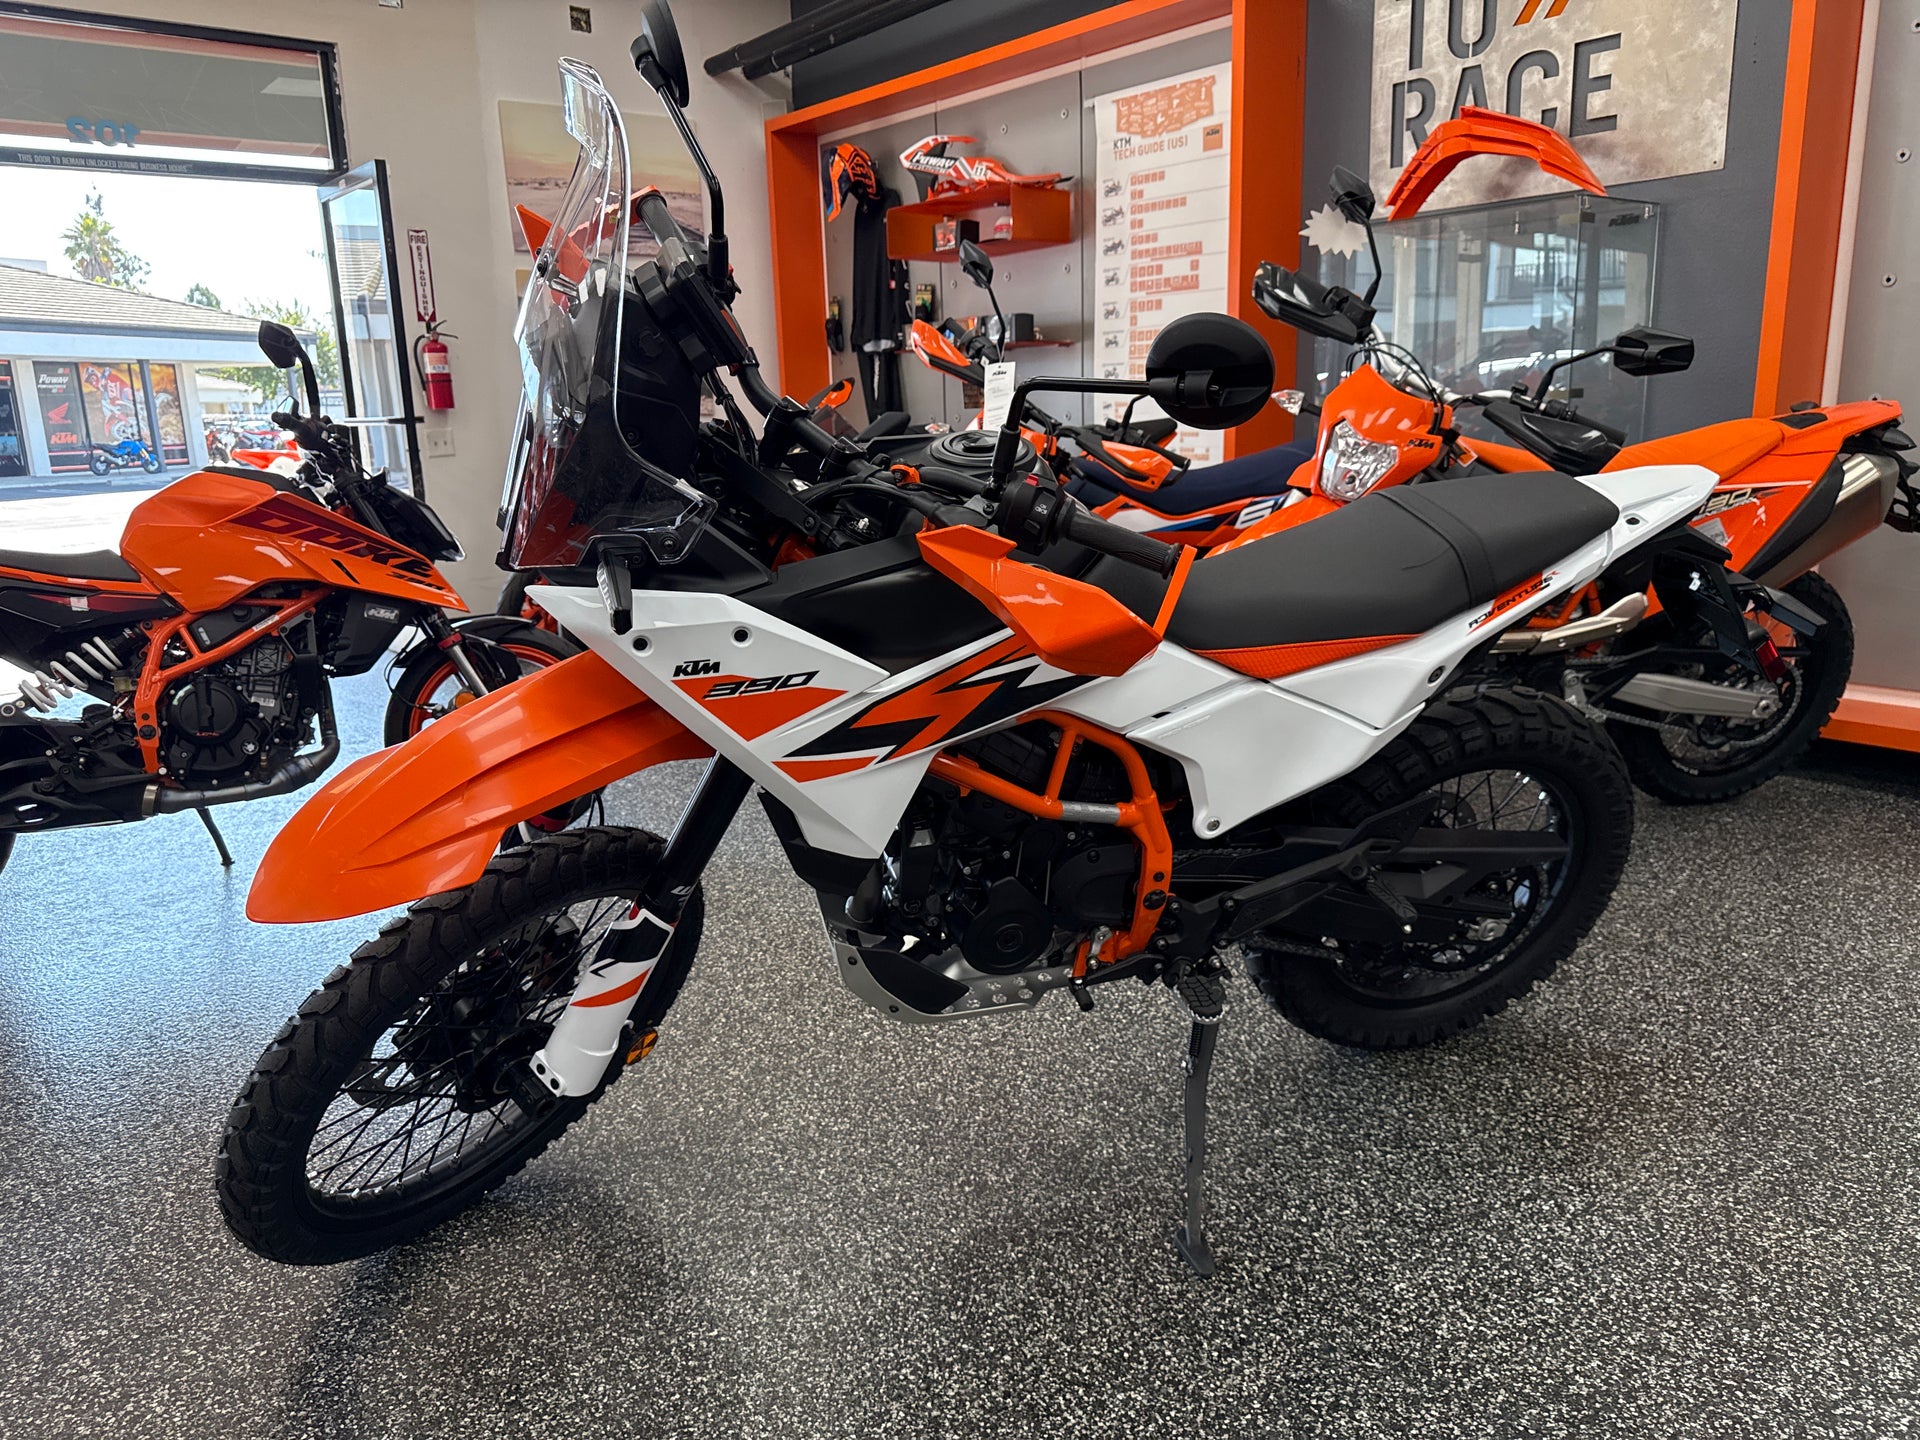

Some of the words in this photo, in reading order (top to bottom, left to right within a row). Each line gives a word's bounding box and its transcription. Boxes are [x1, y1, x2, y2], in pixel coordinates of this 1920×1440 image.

[1390, 32, 1622, 168] RACE
[1113, 136, 1131, 150] KTM
[1114, 147, 1136, 161] TECH
[1138, 140, 1164, 156] GUIDE
[18, 153, 33, 162] THIS
[34, 154, 51, 164] DOOR
[52, 156, 60, 164] TO
[61, 157, 85, 166] REMAIN
[85, 158, 117, 168] UNLOCKED
[117, 161, 139, 170] DURING
[140, 162, 168, 172] BUSINESS
[410, 235, 426, 245] FIRE
[416, 245, 429, 317] EXTINGUISHER
[50, 432, 77, 444] KTM
[1407, 438, 1435, 449] KTM
[226, 500, 433, 578] DUKE
[1468, 575, 1553, 629] ADVENTURE
[366, 607, 399, 620] KTM
[673, 659, 720, 677] KTM
[701, 670, 820, 700] 390
